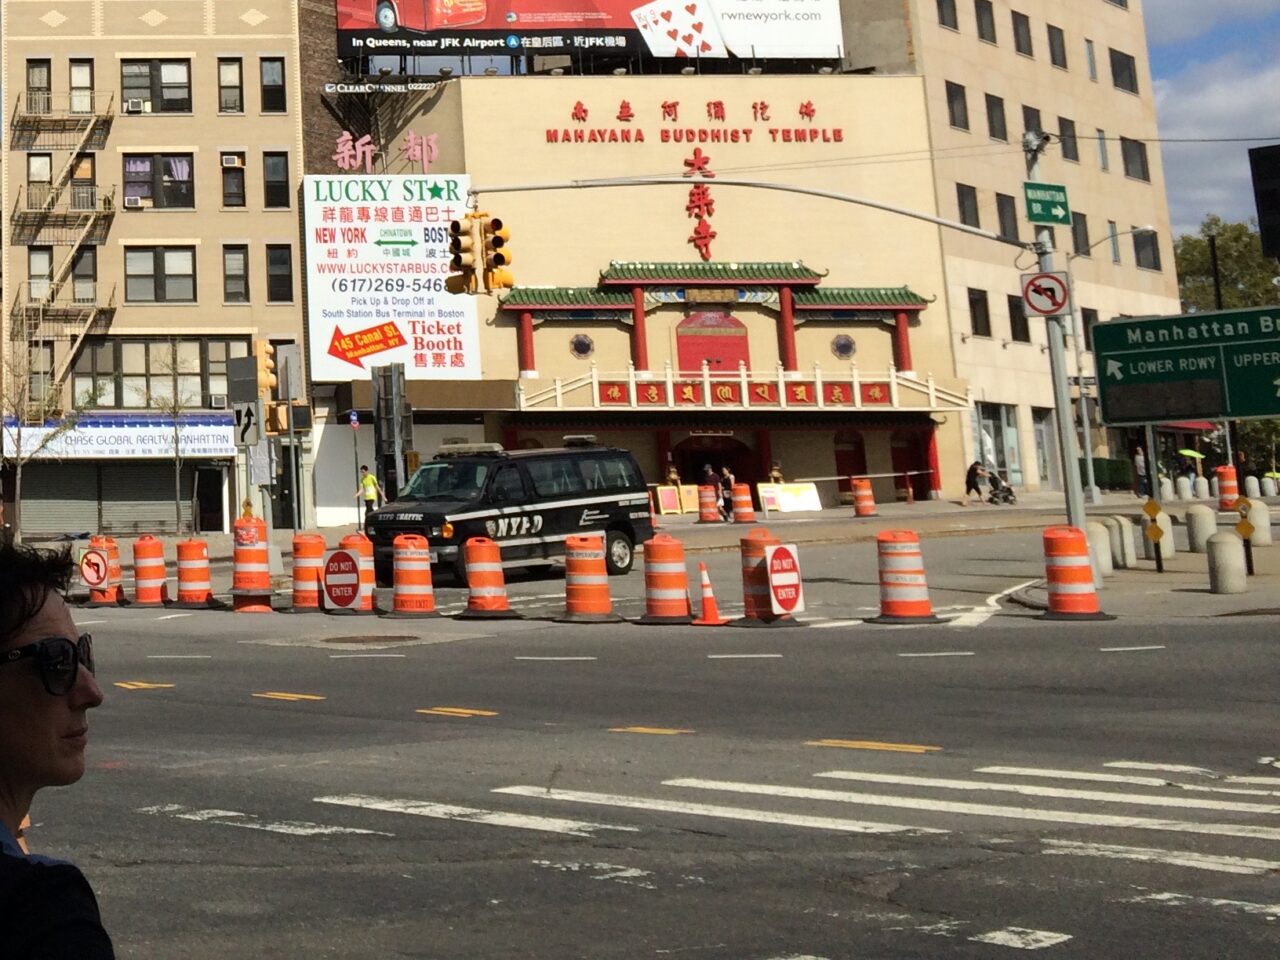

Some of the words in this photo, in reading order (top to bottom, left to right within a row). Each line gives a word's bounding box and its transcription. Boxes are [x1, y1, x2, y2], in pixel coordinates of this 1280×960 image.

[721, 10, 821, 23] rwnewyork.com
[352, 38, 363, 47] In
[366, 38, 411, 49] Queens,
[413, 39, 438, 47] near
[440, 38, 460, 49] JFK
[463, 38, 505, 50] Airport
[546, 128, 645, 143] MAHAYANA
[660, 128, 753, 143] BUDDHIST
[769, 128, 844, 143] TEMPLE
[313, 179, 392, 202] LUCKY
[403, 179, 461, 202] STR
[315, 228, 336, 244] NEW
[341, 228, 367, 244] YORK
[380, 229, 413, 238] CHINATOWN
[424, 227, 449, 243] BOST
[425, 248, 450, 259] 波士
[316, 262, 463, 274] WWW.LUCKYSTARBUS.C
[351, 297, 368, 306] Pick
[370, 297, 381, 307] Up
[383, 297, 389, 306] &
[391, 297, 410, 308] Drop
[412, 297, 424, 306] Off
[427, 297, 435, 306] at
[322, 309, 344, 318] South
[346, 309, 373, 318] Station
[376, 309, 390, 318] Bus
[393, 309, 426, 318] Terminal
[428, 309, 435, 318] in
[438, 309, 465, 318] Boston
[408, 321, 462, 335] Ticket
[1126, 320, 1250, 344] Manhattan
[334, 337, 354, 352] 145
[354, 328, 383, 346] Canal
[384, 324, 400, 338] St.
[388, 338, 399, 346] NY
[413, 336, 463, 351] Booth
[413, 352, 465, 368] 售票處
[1129, 359, 1174, 375] LOWER
[1179, 356, 1216, 372] RDWY
[1233, 351, 1280, 368] UPPER
[96, 435, 134, 445] GLOBAL
[136, 435, 169, 445] REALTY
[171, 434, 229, 445] MANHATTAN
[396, 513, 424, 521] TRAFFIC
[497, 514, 543, 537] NYPD
[330, 562, 338, 572] DO
[340, 561, 353, 571] NOT
[773, 559, 781, 570] DO
[782, 558, 794, 569] NOT
[332, 587, 353, 597] ENTER
[778, 588, 797, 600] ENTER
